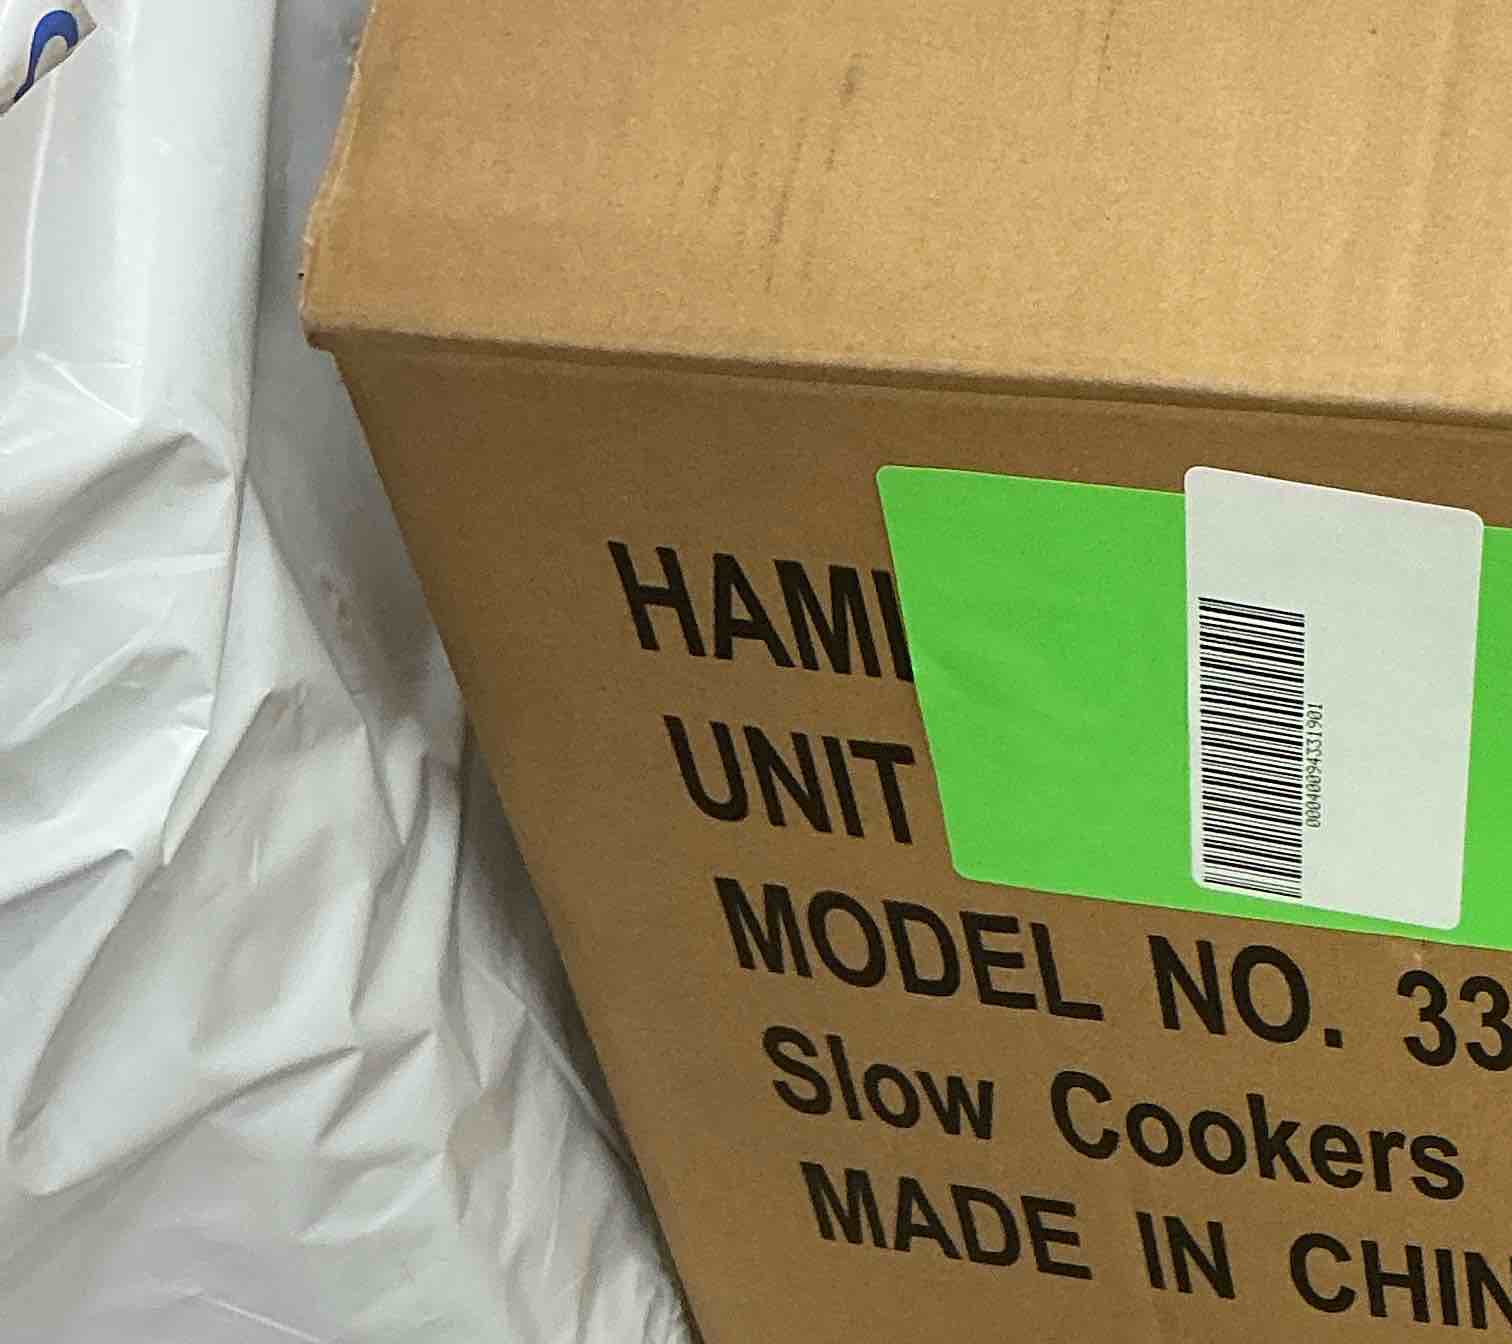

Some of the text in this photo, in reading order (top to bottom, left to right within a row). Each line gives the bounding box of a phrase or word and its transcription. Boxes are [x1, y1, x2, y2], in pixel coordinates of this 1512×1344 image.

[664, 715, 916, 845] UNIT
[1306, 704, 1324, 829] 00040094331901
[714, 876, 1103, 1022] MODEL
[1148, 935, 1345, 1048] NO.
[761, 1026, 1465, 1200] Slow Cookers
[800, 1160, 1092, 1280] MADE
[1136, 1212, 1236, 1300] IN
